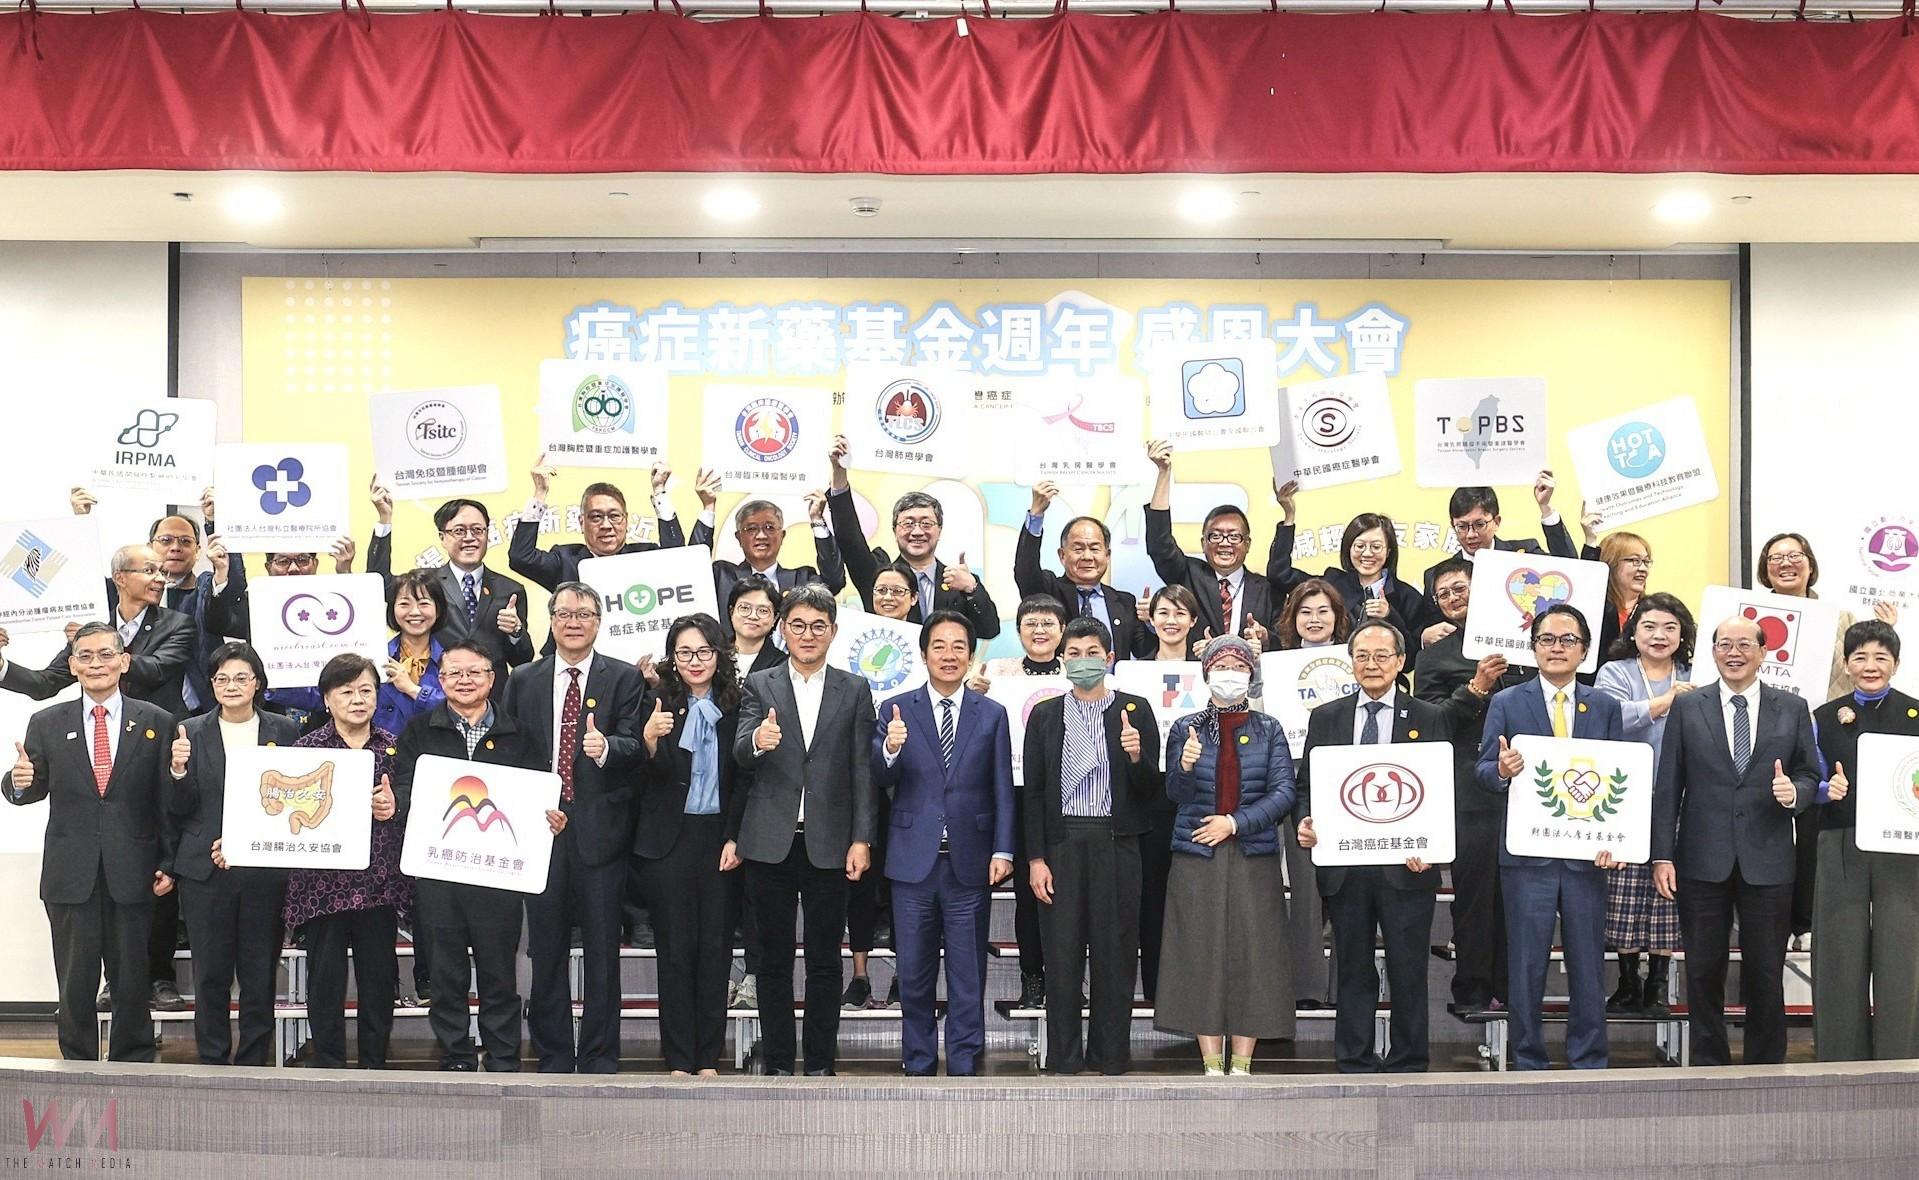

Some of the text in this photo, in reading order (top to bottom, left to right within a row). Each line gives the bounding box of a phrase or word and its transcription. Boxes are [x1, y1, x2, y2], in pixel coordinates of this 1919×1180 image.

[568, 306, 1406, 373] 癌症新藥基金週年 感恩大會
[416, 420, 457, 440] Tsitc
[548, 443, 658, 455] 台灣胸腔暨重症加護醫學會
[1611, 428, 1654, 455] HOT
[115, 450, 176, 468] IRPMA
[874, 449, 934, 463] 台灣肺癌學會
[394, 463, 488, 481] 台灣免疫暨腫瘤學會
[724, 470, 807, 481] 台灣臨床腫瘤醫學會
[1293, 455, 1380, 478] 中華民國癌症醫學會
[609, 617, 672, 637] 癌症希望基
[265, 787, 327, 801] 腸治久安
[250, 840, 343, 854] 台灣腸治久安協會
[1338, 836, 1429, 851] 台灣癌症基金會
[427, 846, 525, 872] 乳癌防治基金會
